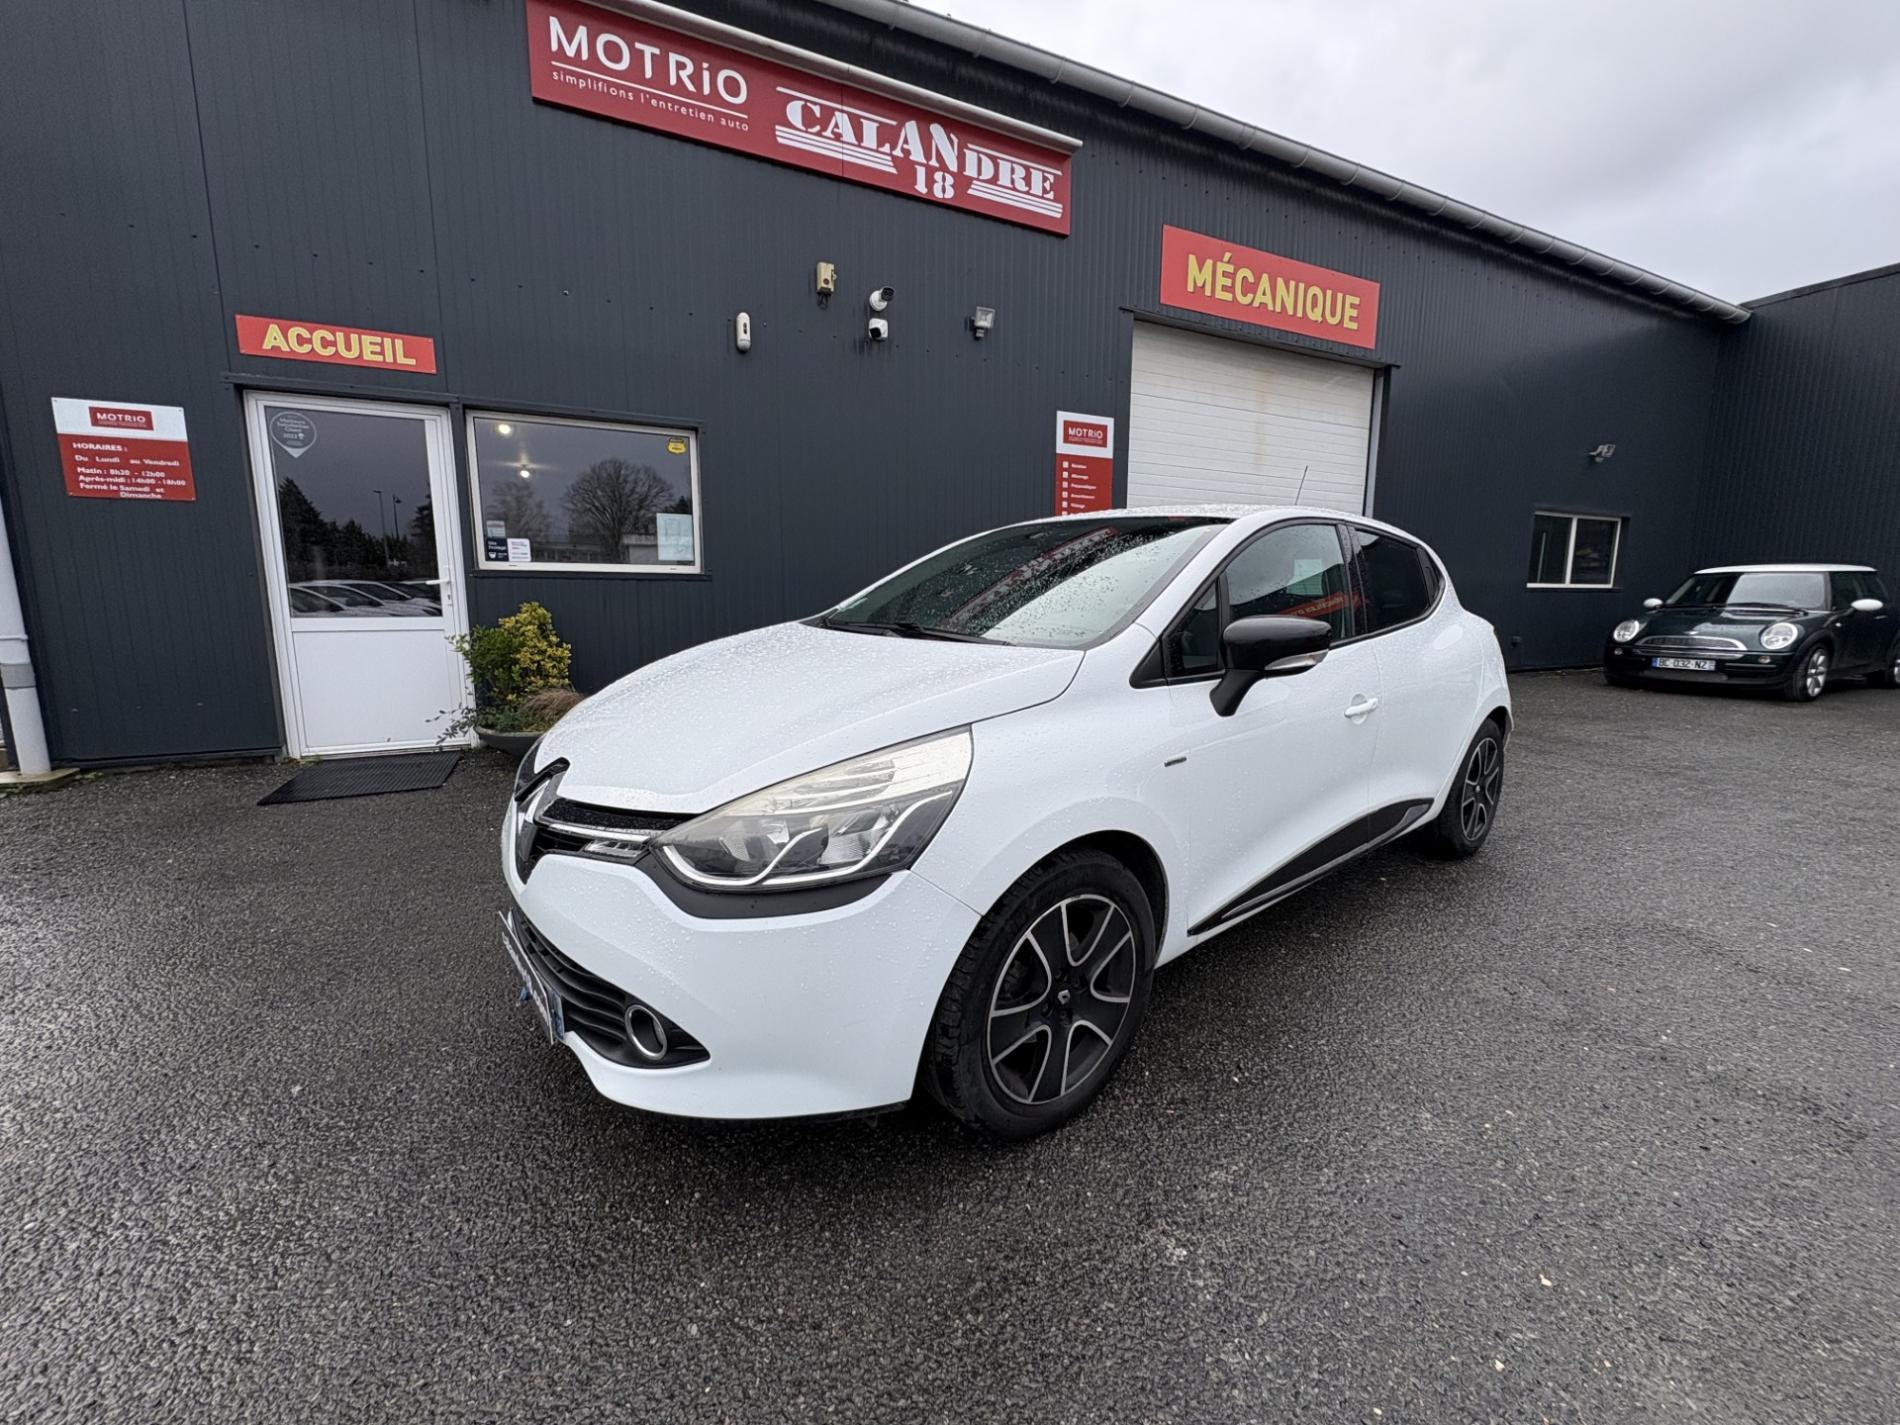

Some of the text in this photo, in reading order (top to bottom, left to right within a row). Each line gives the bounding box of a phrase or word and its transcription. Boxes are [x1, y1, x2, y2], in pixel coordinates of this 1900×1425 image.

[552, 70, 749, 132] simplifions l'entretien auto
[786, 100, 1055, 200] CALANDRE
[914, 165, 955, 199] 18
[1187, 251, 1360, 330] MÉCANIQUE
[262, 323, 416, 366] ACCUEIL
[72, 442, 122, 451] HORAIRES
